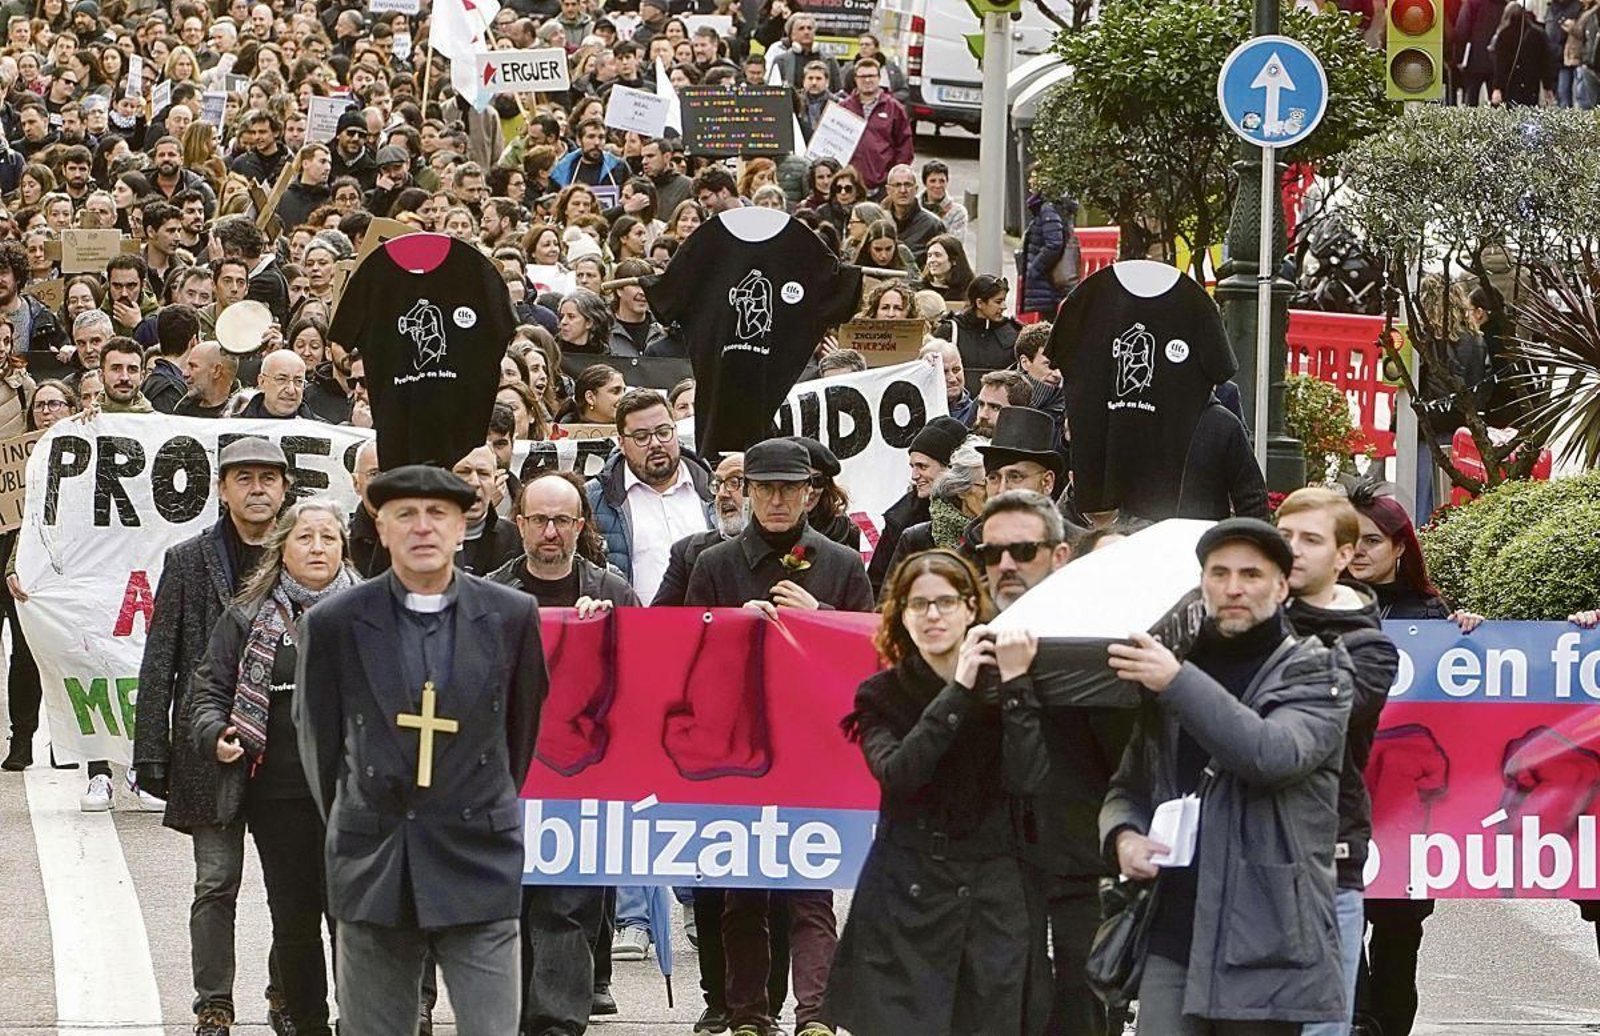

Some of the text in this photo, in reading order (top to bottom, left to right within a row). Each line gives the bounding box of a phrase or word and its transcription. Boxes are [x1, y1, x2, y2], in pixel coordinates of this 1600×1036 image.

[501, 61, 561, 82] ERGUER
[1437, 648, 1528, 698] en
[523, 793, 842, 880] bilízate
[1408, 808, 1597, 899] públ
